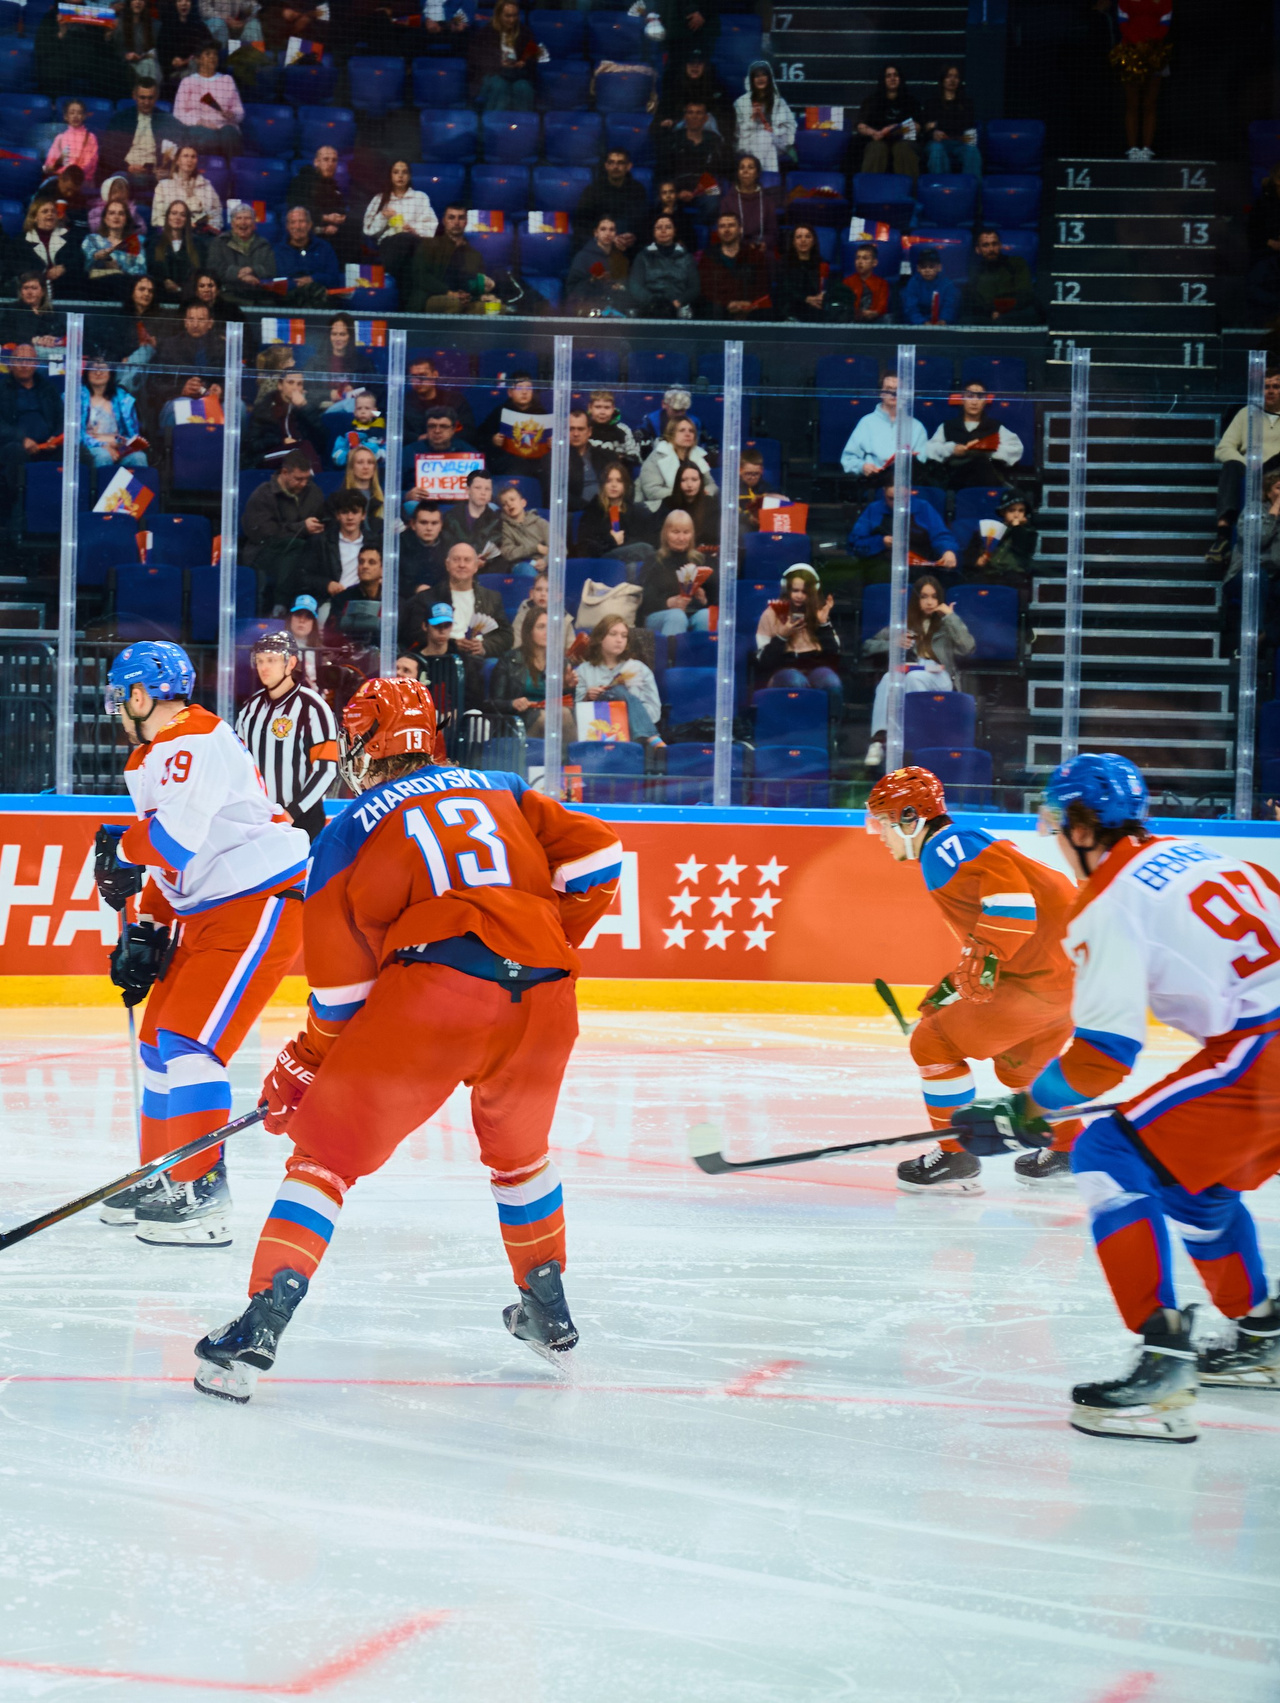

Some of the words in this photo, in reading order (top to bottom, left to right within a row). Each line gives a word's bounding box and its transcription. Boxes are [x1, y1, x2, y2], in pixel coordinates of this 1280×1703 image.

[780, 63, 805, 81] 16
[1065, 168, 1091, 188] 14
[1181, 168, 1206, 188] 14
[1058, 221, 1085, 243] 13
[1182, 222, 1209, 244] 13
[1054, 281, 1081, 302] 12
[1181, 282, 1208, 304] 12
[1053, 339, 1075, 362] 11
[1183, 343, 1205, 367] 11
[420, 476, 468, 490] ВПЕРЕ
[406, 731, 422, 750] 13
[353, 767, 492, 833] ZHAROVSKY
[403, 796, 512, 897] 13
[935, 835, 966, 868] 17
[278, 1050, 315, 1086] AUE
